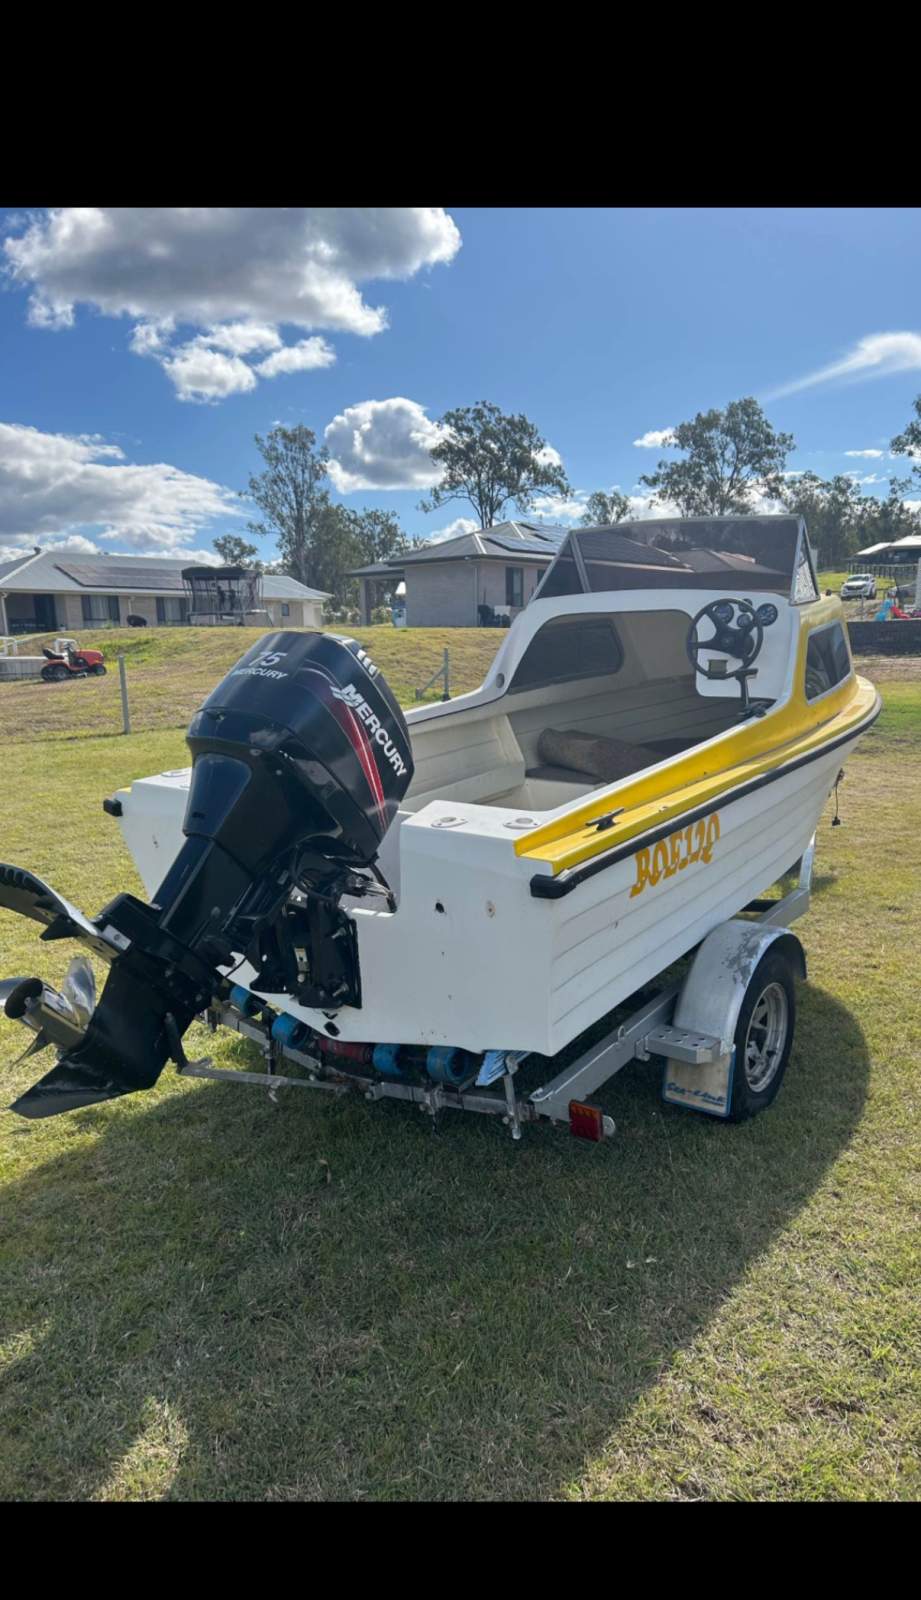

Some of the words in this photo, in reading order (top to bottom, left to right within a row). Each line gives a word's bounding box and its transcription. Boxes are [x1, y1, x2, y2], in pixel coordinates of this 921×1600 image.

[249, 651, 287, 667] 75
[232, 667, 288, 680] MERCURY
[335, 684, 407, 777] MERCURY
